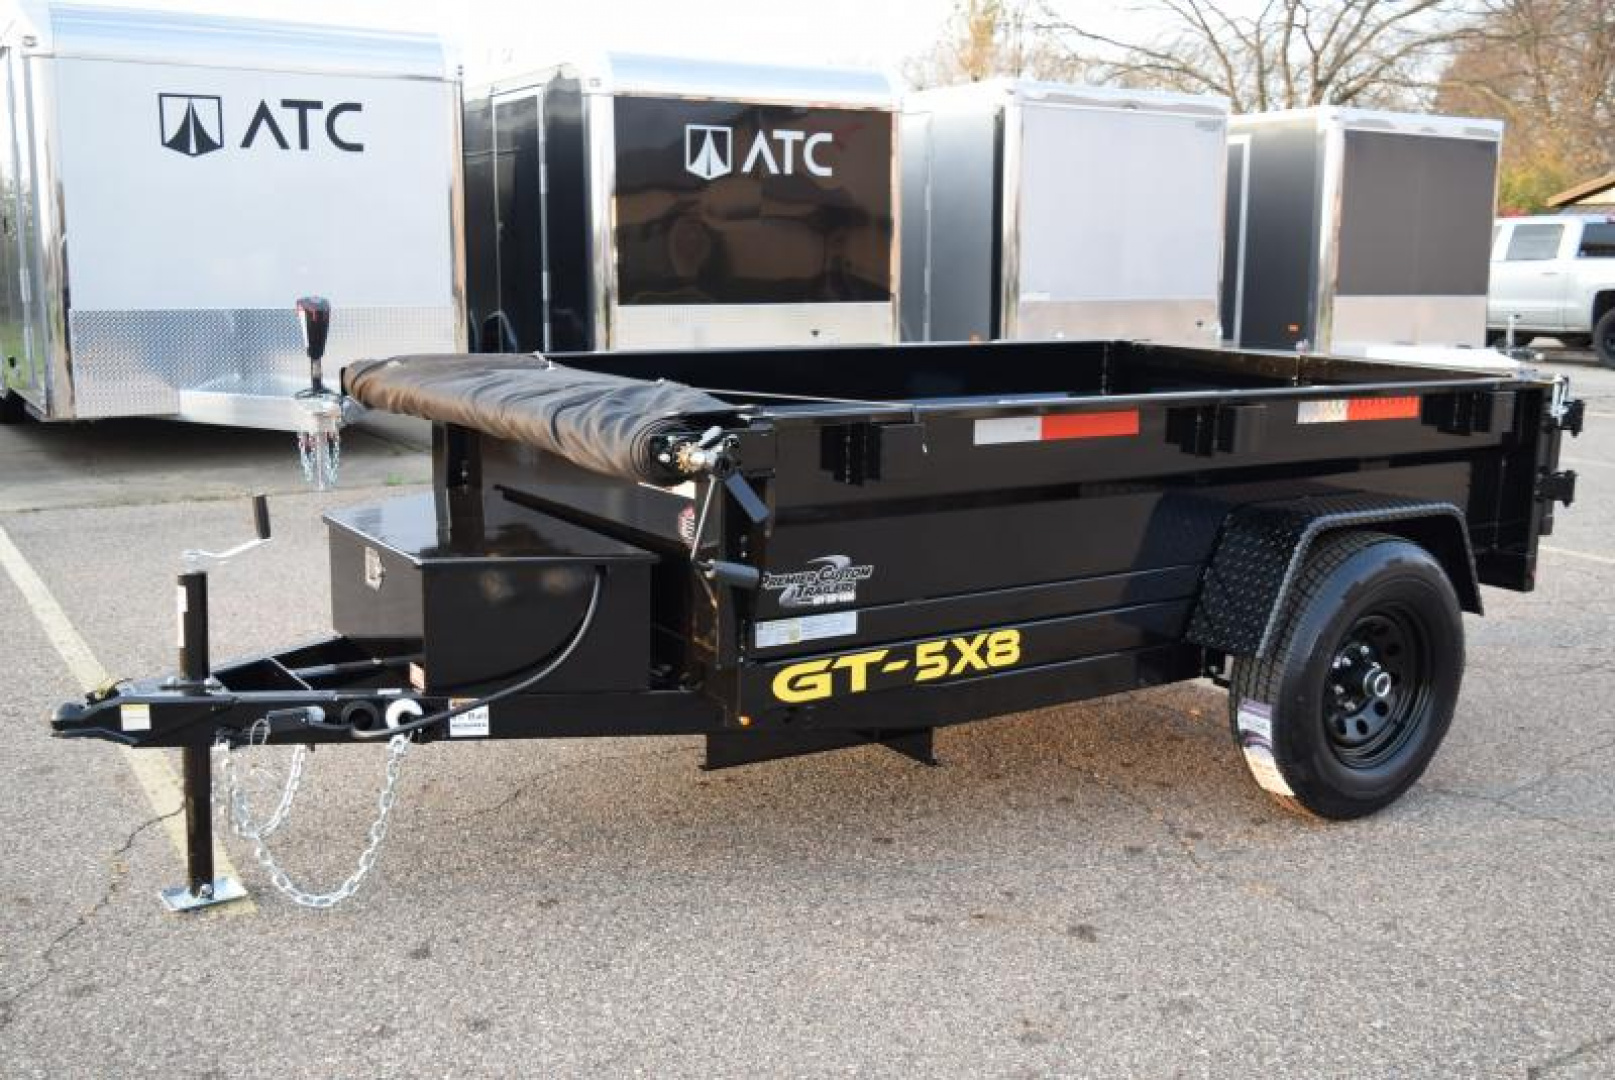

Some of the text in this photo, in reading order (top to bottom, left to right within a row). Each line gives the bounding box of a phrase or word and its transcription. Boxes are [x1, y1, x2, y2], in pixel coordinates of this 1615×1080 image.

[239, 98, 364, 152] ATC
[742, 128, 833, 177] ATC
[772, 629, 1021, 703] GT-5X8
